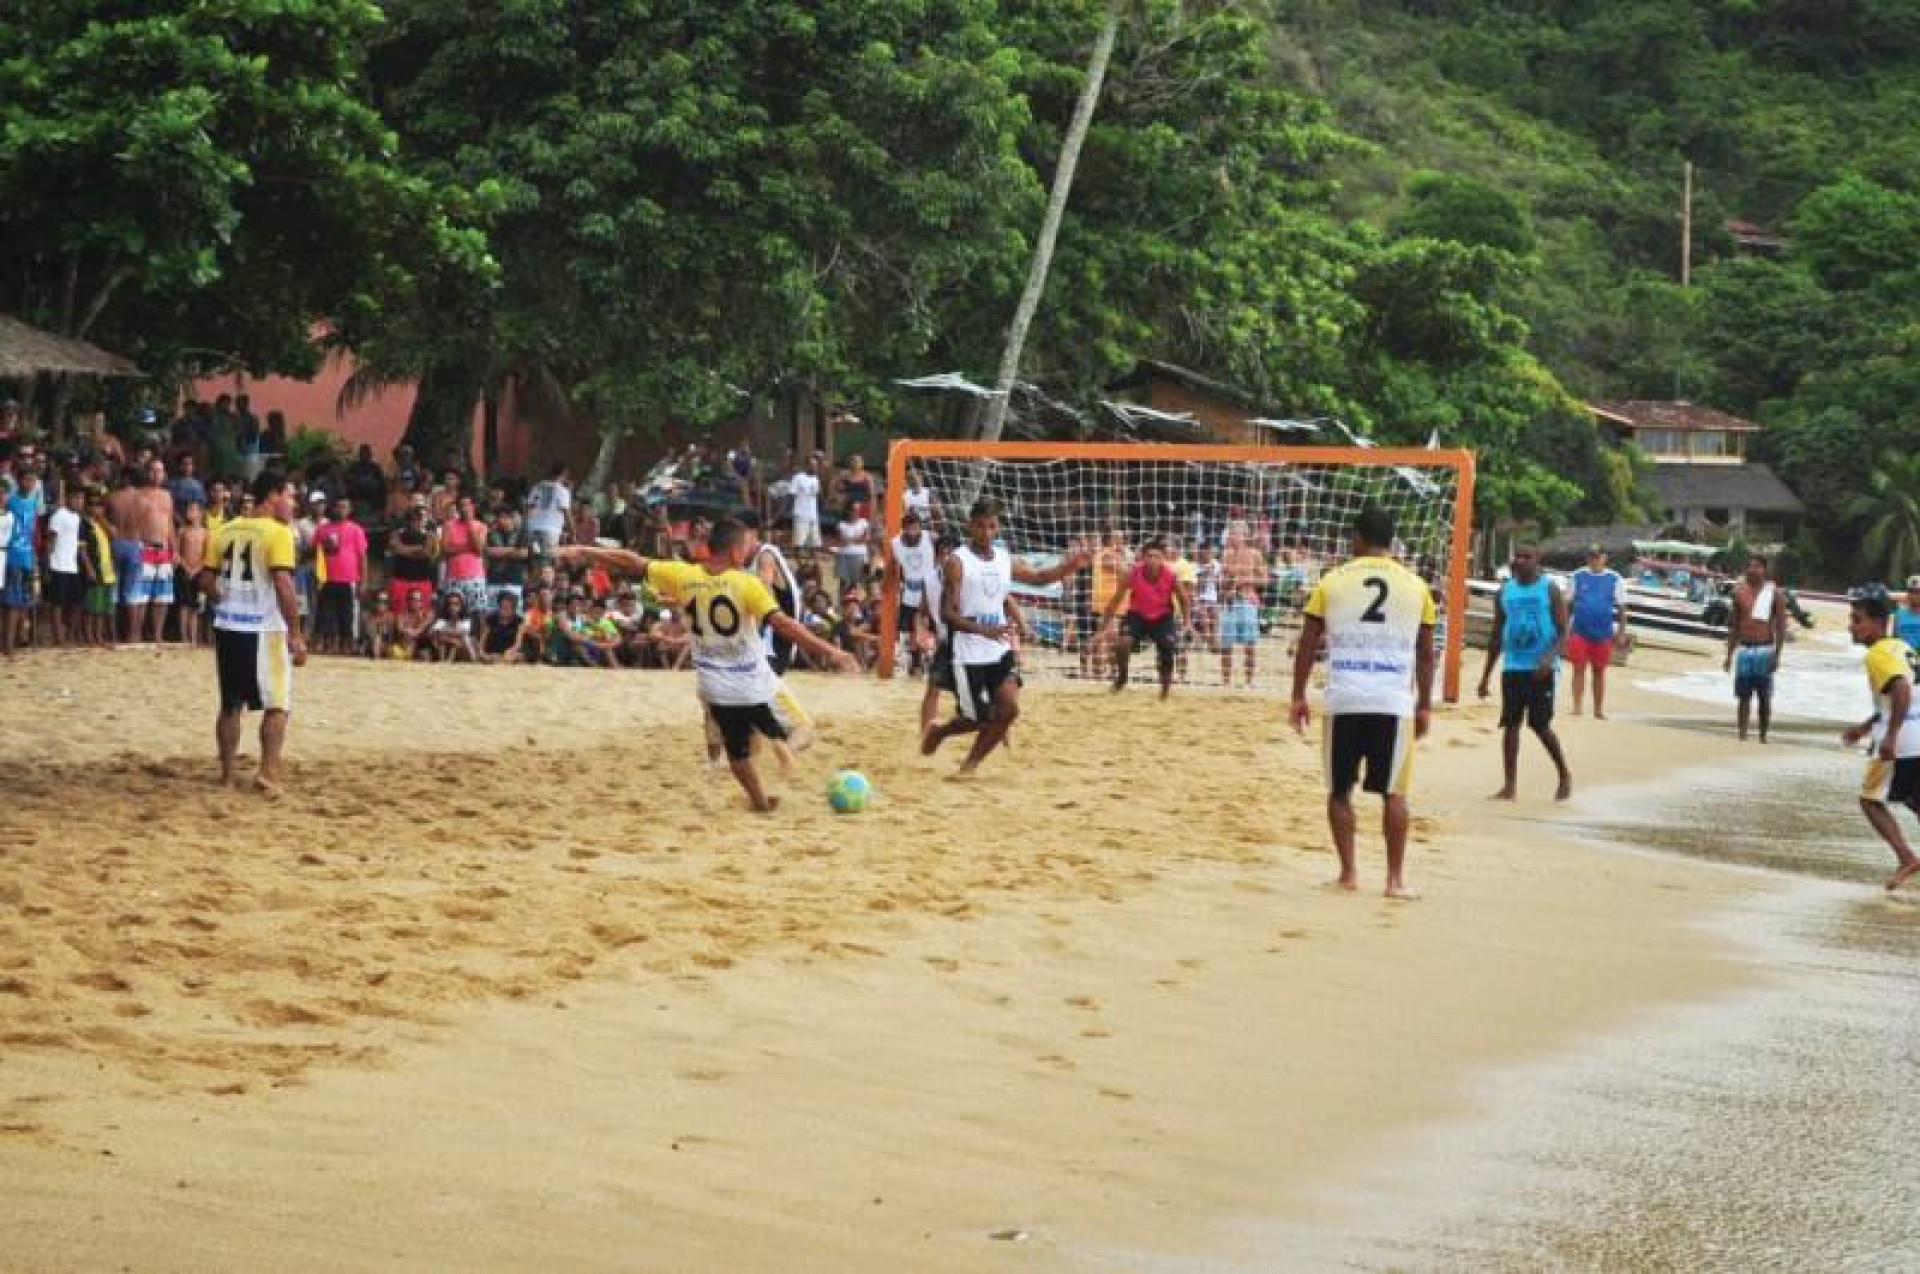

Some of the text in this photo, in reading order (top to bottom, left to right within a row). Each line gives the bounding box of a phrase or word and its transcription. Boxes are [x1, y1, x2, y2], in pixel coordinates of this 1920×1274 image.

[222, 539, 253, 581] 11
[686, 594, 740, 636] 10
[1360, 576, 1390, 622] 2
